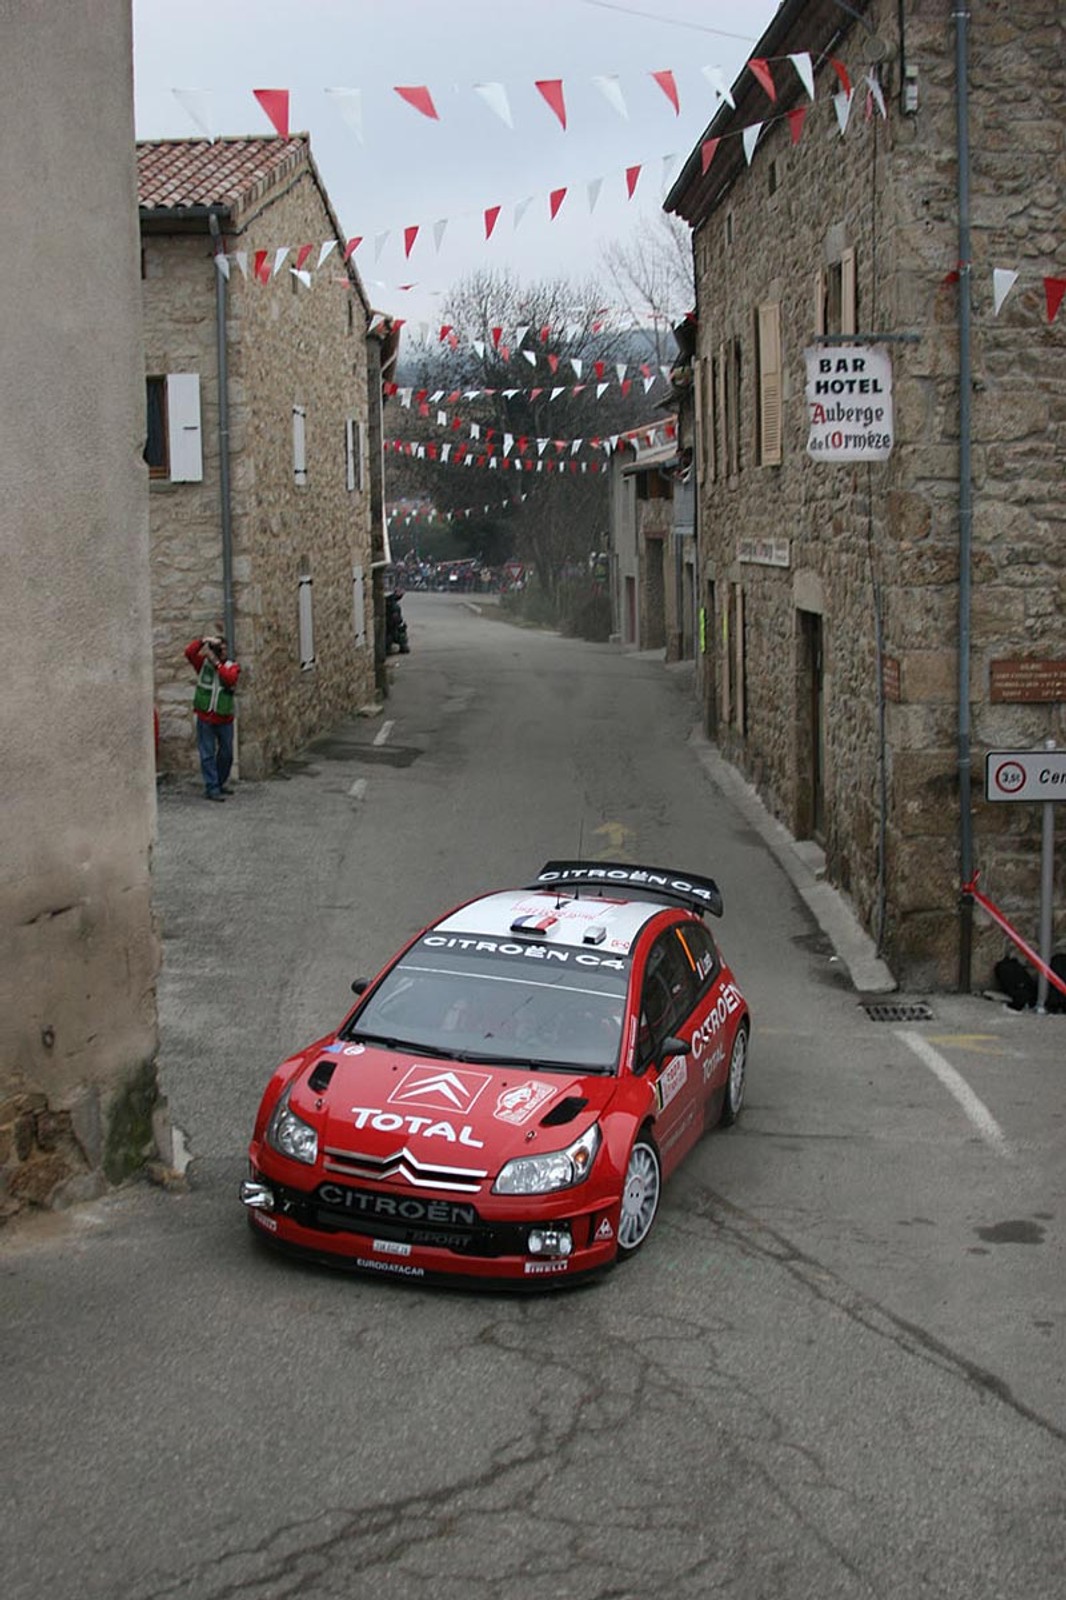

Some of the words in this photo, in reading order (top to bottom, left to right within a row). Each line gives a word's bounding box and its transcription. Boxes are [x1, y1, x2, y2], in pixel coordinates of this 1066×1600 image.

[819, 358, 865, 373] BAR
[815, 379, 883, 394] HOTEL
[809, 401, 885, 427] Auberge
[538, 869, 668, 886] CITROËN
[671, 881, 712, 899] C4
[425, 936, 569, 962] CITROËN
[575, 955, 624, 970] C4
[351, 1107, 484, 1148] TOTAL
[319, 1184, 475, 1224] CITROËN
